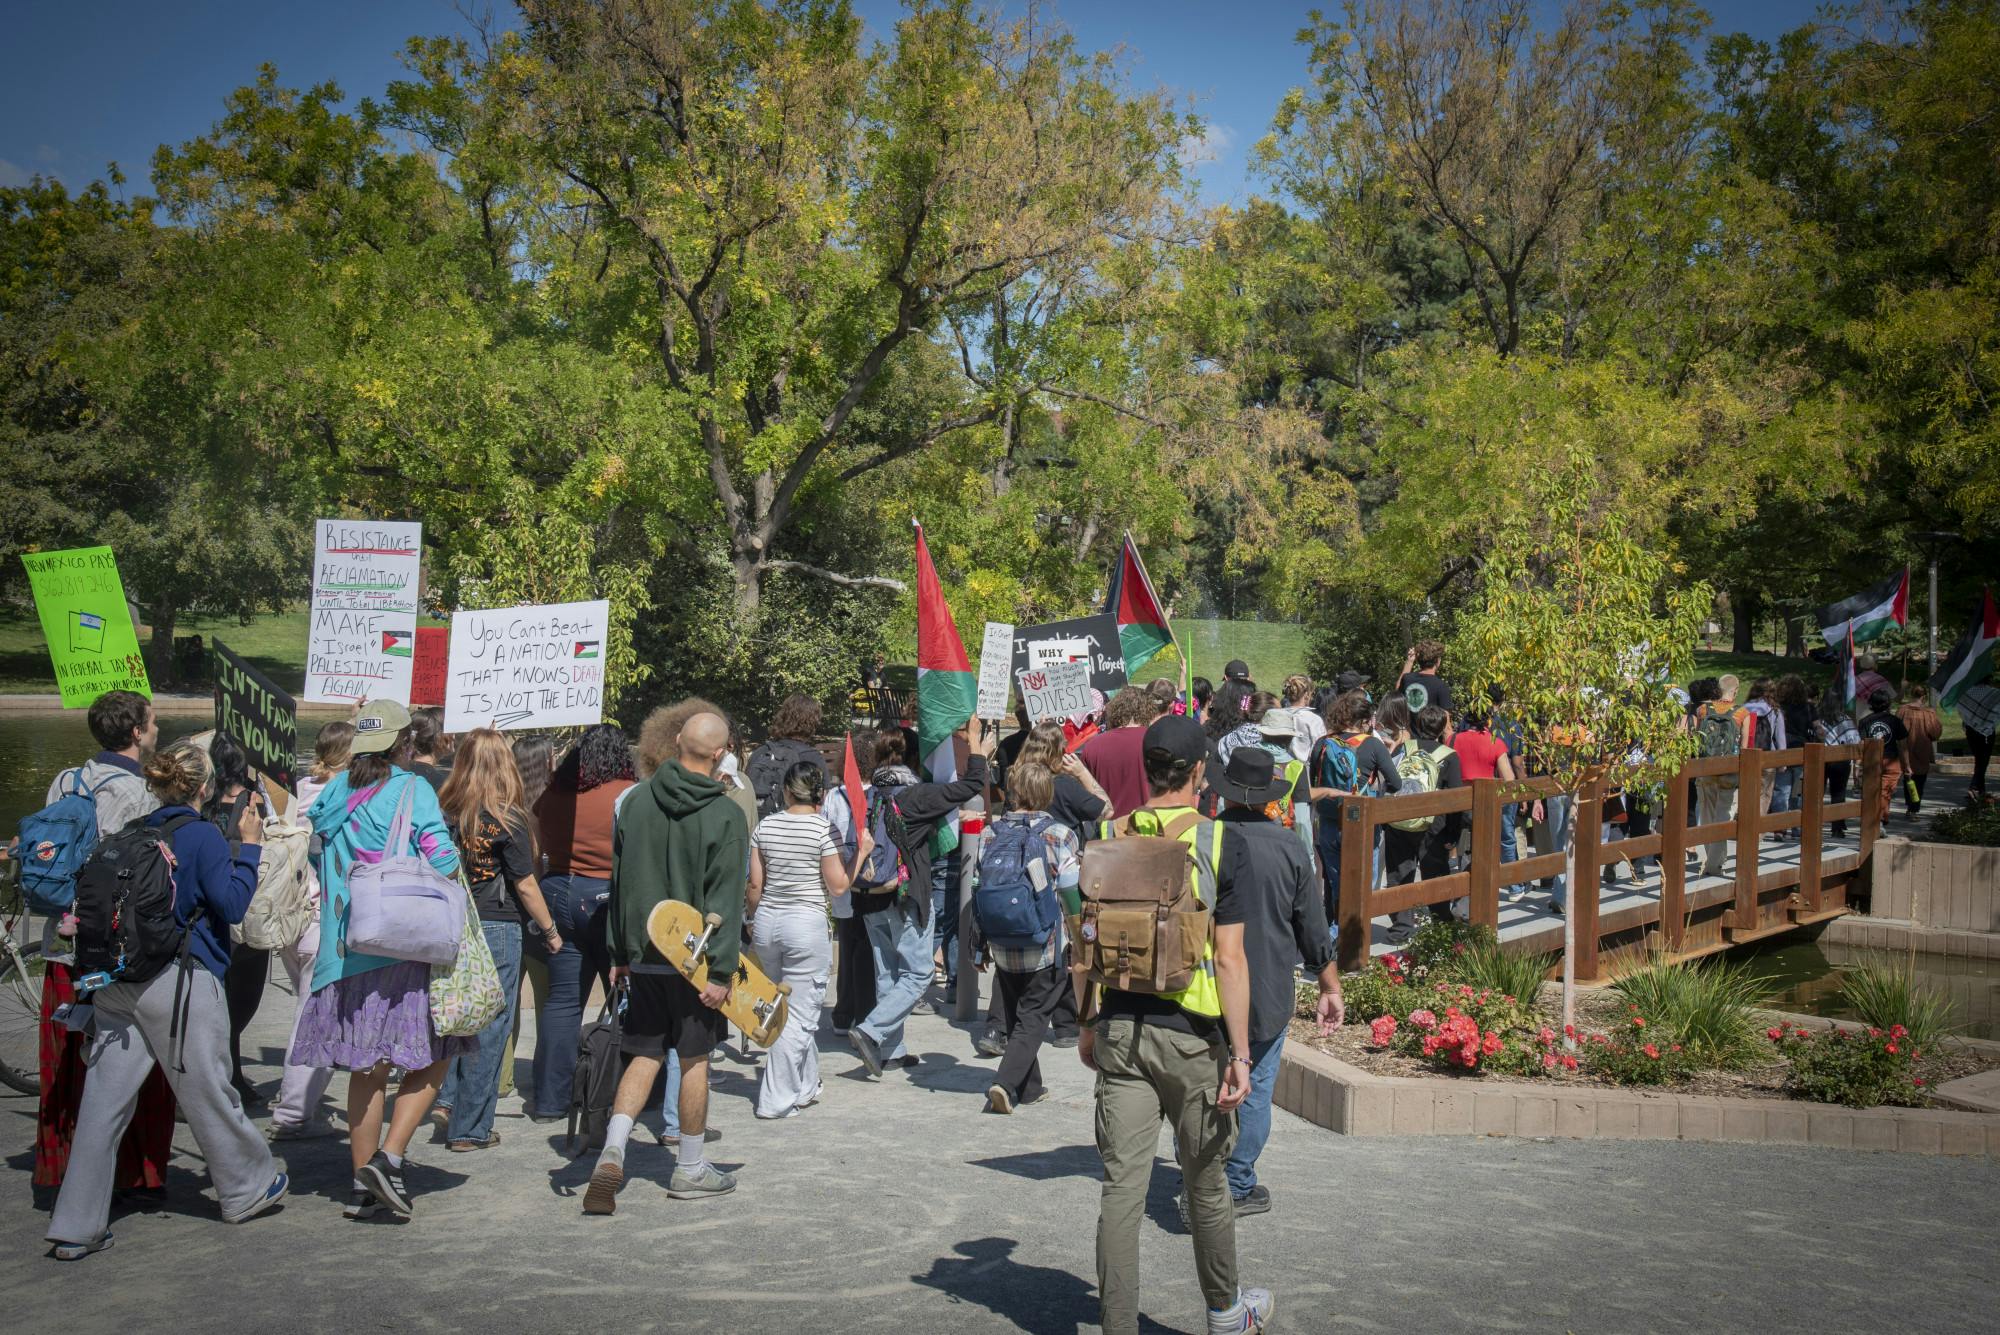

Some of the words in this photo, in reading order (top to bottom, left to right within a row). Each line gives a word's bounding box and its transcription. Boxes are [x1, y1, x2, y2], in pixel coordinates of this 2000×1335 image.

[326, 523, 417, 550] RESISTANCE
[45, 556, 85, 574] MEXICO
[89, 553, 115, 568] PAYS
[316, 610, 384, 637] MAKE
[470, 617, 503, 658] You
[550, 617, 593, 637] Beat
[494, 644, 505, 665] A
[1038, 648, 1064, 658] WHY
[1096, 653, 1126, 675] Project
[57, 663, 69, 678] IN
[69, 660, 110, 678] FEDERAL
[310, 654, 394, 679] PALESTINE
[457, 668, 504, 687] THAT
[513, 666, 569, 684] KNOWS
[573, 665, 602, 683] DEATH
[217, 651, 297, 737] INTIFADA
[322, 676, 371, 696] AGAIN
[460, 693, 493, 713] IS
[496, 691, 534, 712] NOT
[538, 688, 560, 710] THE
[1028, 683, 1088, 715] DIVEST
